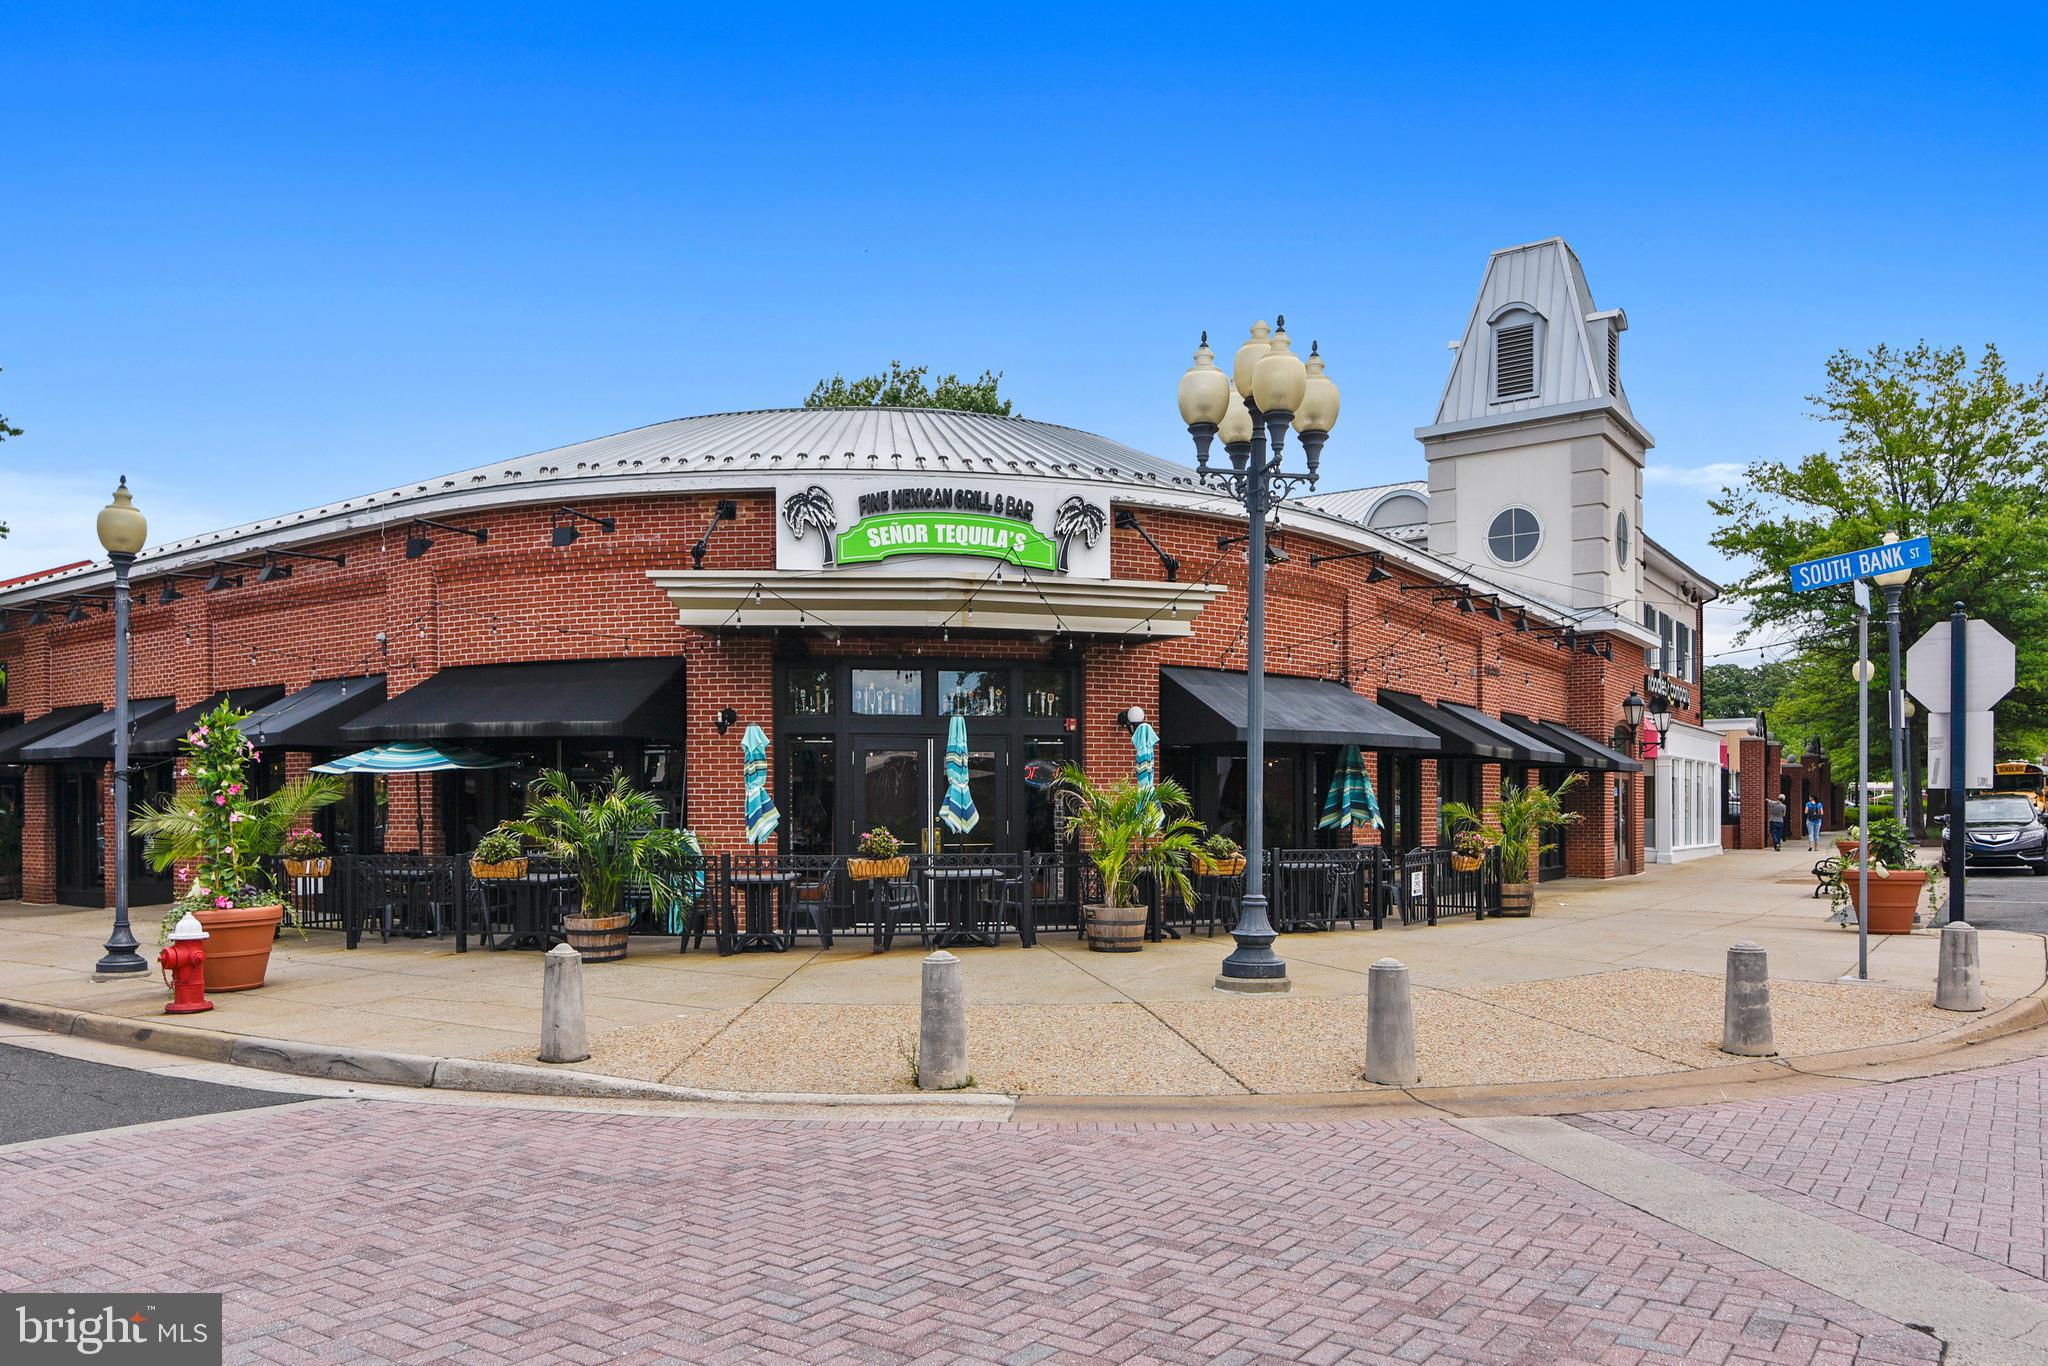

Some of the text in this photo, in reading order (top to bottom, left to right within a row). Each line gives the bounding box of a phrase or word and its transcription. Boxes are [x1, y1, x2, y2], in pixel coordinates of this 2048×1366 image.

[858, 488, 1034, 521] FINE MEXICAN GRILL & BAR
[867, 521, 1025, 552] SEÑOR TEQUILA'S
[1800, 546, 1920, 587] SOUTH BANK ST
